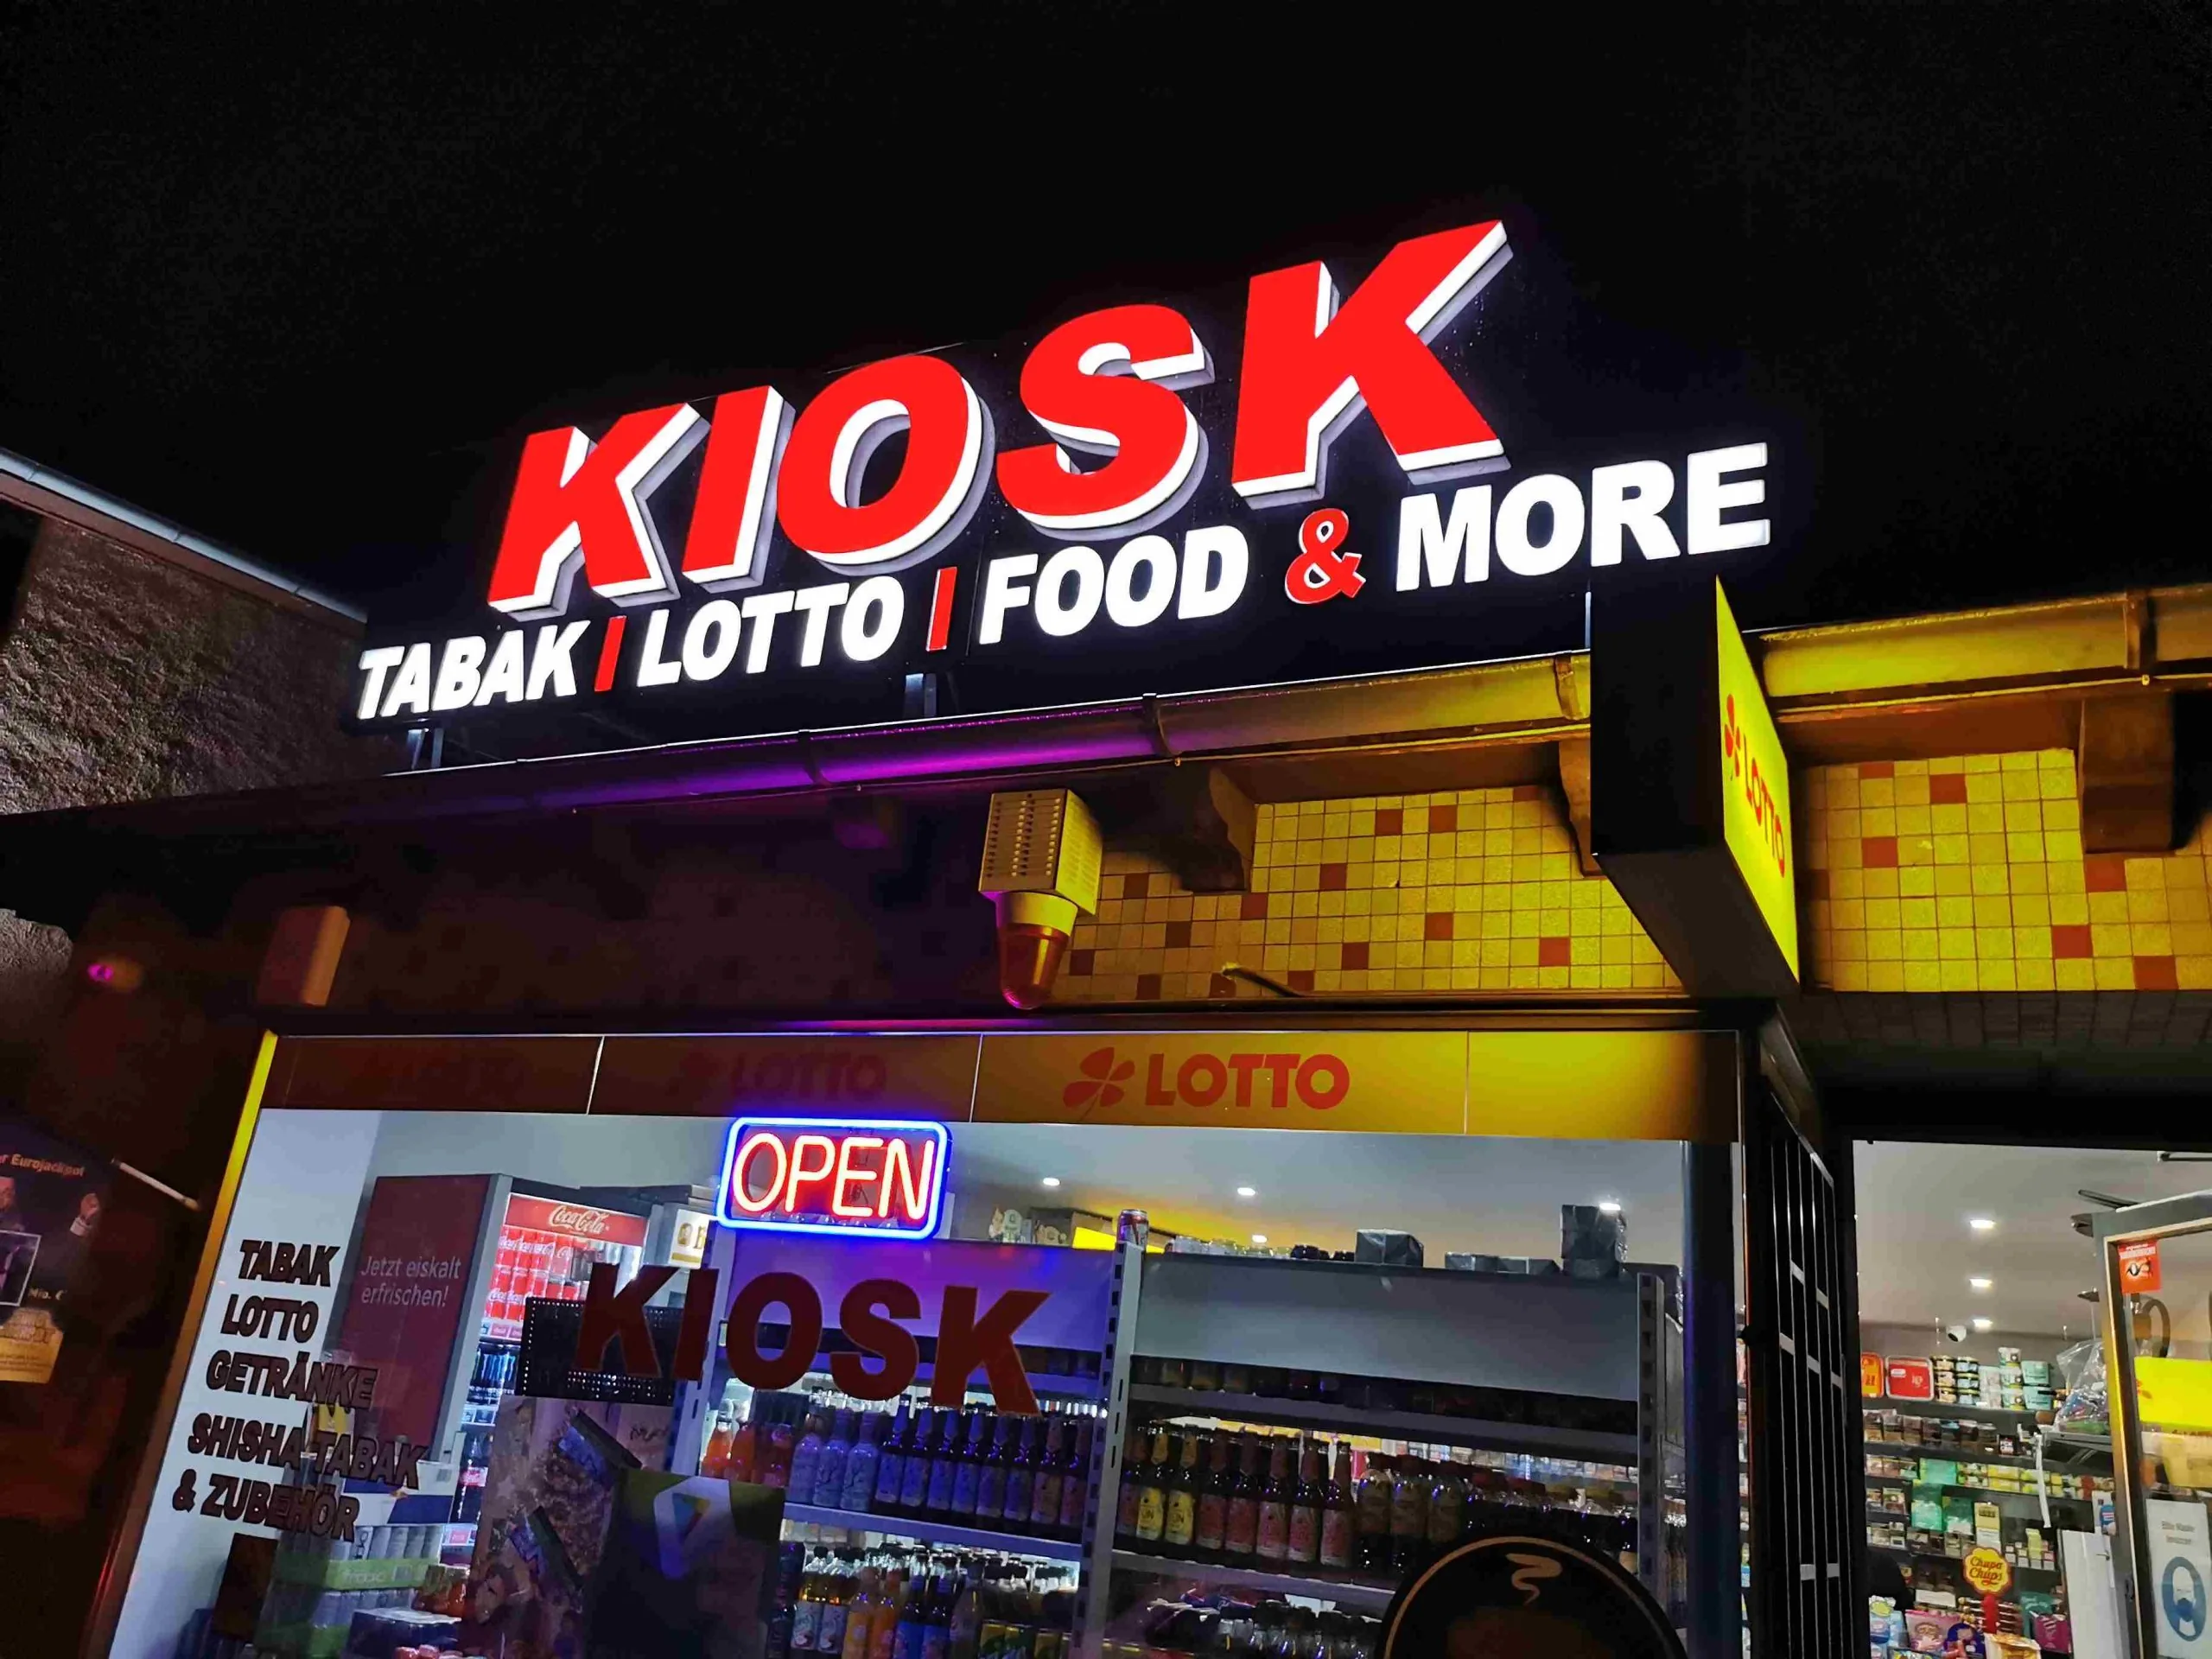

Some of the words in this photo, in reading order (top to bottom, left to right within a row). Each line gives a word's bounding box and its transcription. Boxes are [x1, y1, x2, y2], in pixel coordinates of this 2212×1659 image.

[489, 219, 1512, 620] KIOSK
[357, 619, 591, 721] TABAK
[634, 574, 906, 690] LOTTO
[977, 524, 1249, 646] FOOD
[1284, 507, 1367, 606] &
[1395, 442, 1771, 594] MORE
[1743, 733, 1786, 879] LOTTO
[1145, 1052, 1351, 1110] LOTTO
[730, 1129, 937, 1222] OPEN
[238, 1239, 340, 1287] TABAK
[361, 1255, 403, 1277] Jetzt
[406, 1255, 461, 1280] eiskalt
[220, 1294, 320, 1344] LOTTO
[361, 1282, 449, 1307] erfrischen!
[575, 1262, 1056, 1419] KIOSK
[206, 1349, 378, 1411] GETRÄNKE
[172, 1468, 197, 1512] &
[200, 1472, 360, 1543] ZUBEHÖR
[1970, 1556, 2003, 1570] Chupa
[1970, 1567, 2003, 1581] Chups
